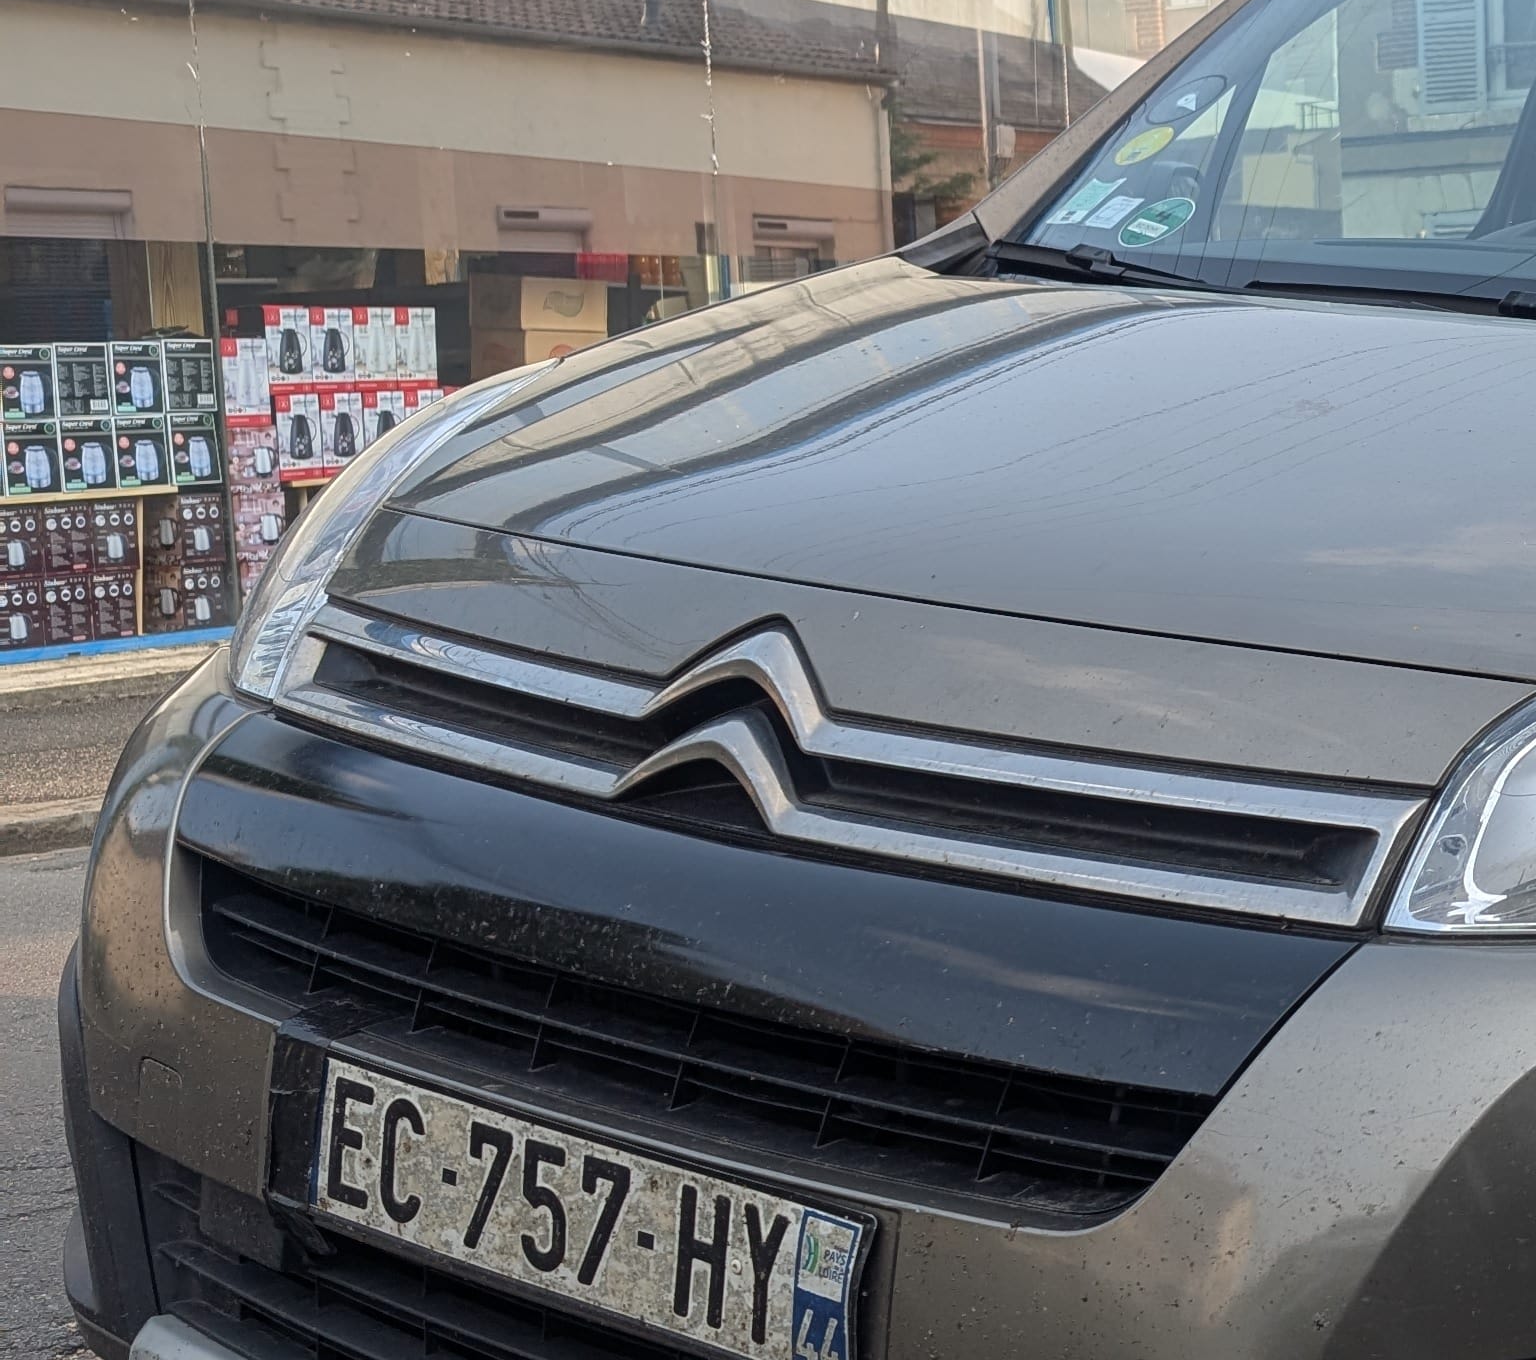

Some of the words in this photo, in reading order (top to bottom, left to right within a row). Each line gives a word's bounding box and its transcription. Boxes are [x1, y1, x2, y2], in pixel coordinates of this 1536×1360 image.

[327, 1076, 790, 1344] EC-757-HY
[823, 1249, 847, 1266] PAYS
[818, 1266, 845, 1284] LOIRE
